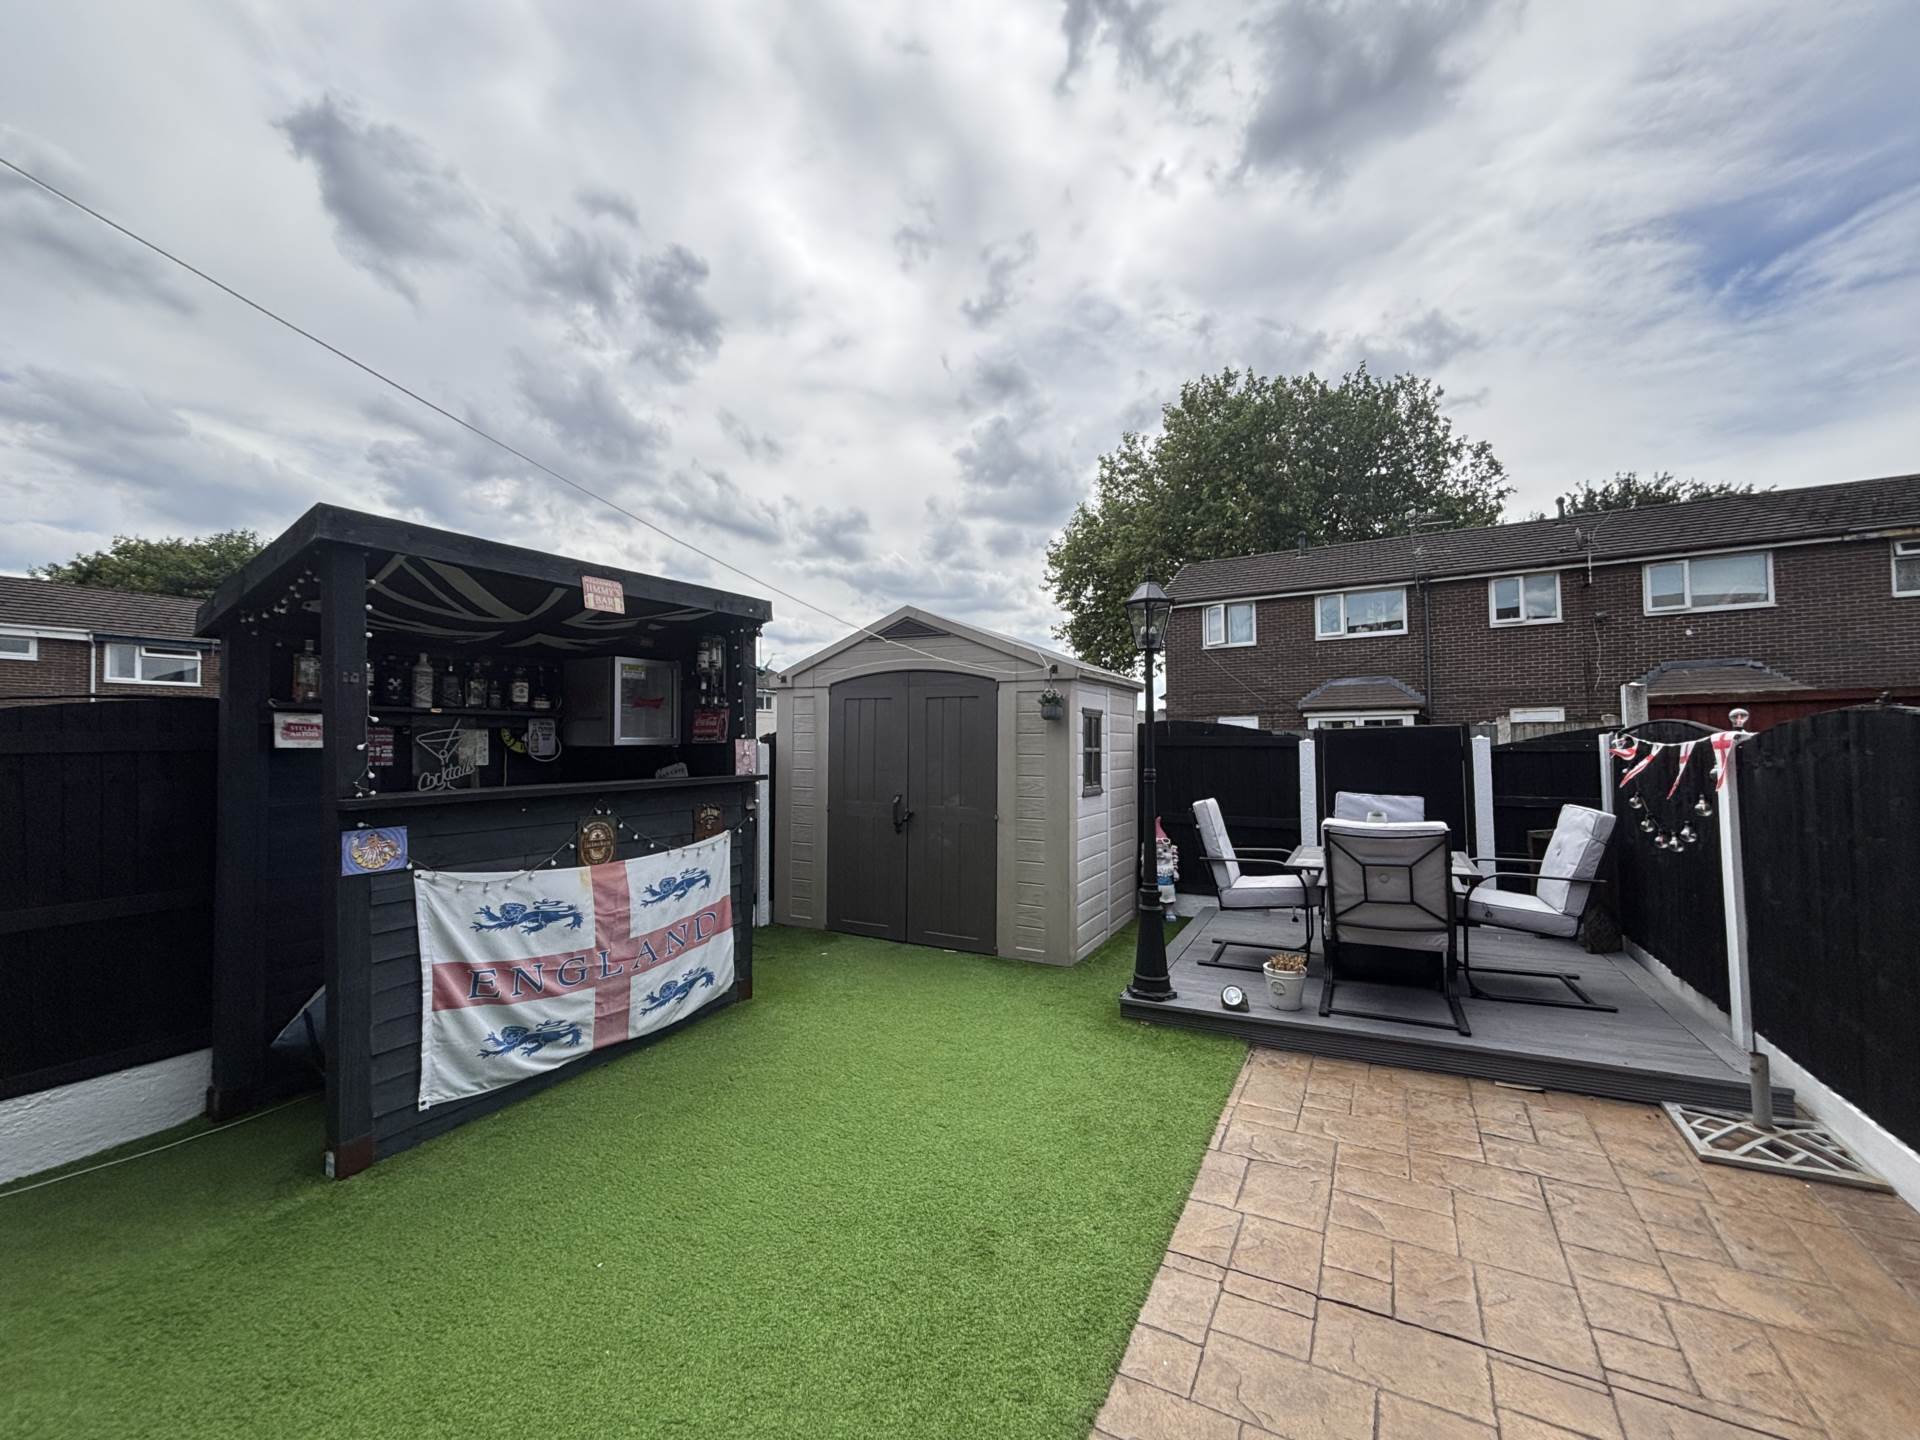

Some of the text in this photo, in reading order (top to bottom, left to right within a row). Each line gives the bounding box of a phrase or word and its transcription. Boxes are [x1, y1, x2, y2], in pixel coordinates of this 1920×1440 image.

[594, 595, 615, 607] BAR
[418, 762, 476, 791] Cocktails
[468, 911, 717, 1000] ENGLAND
